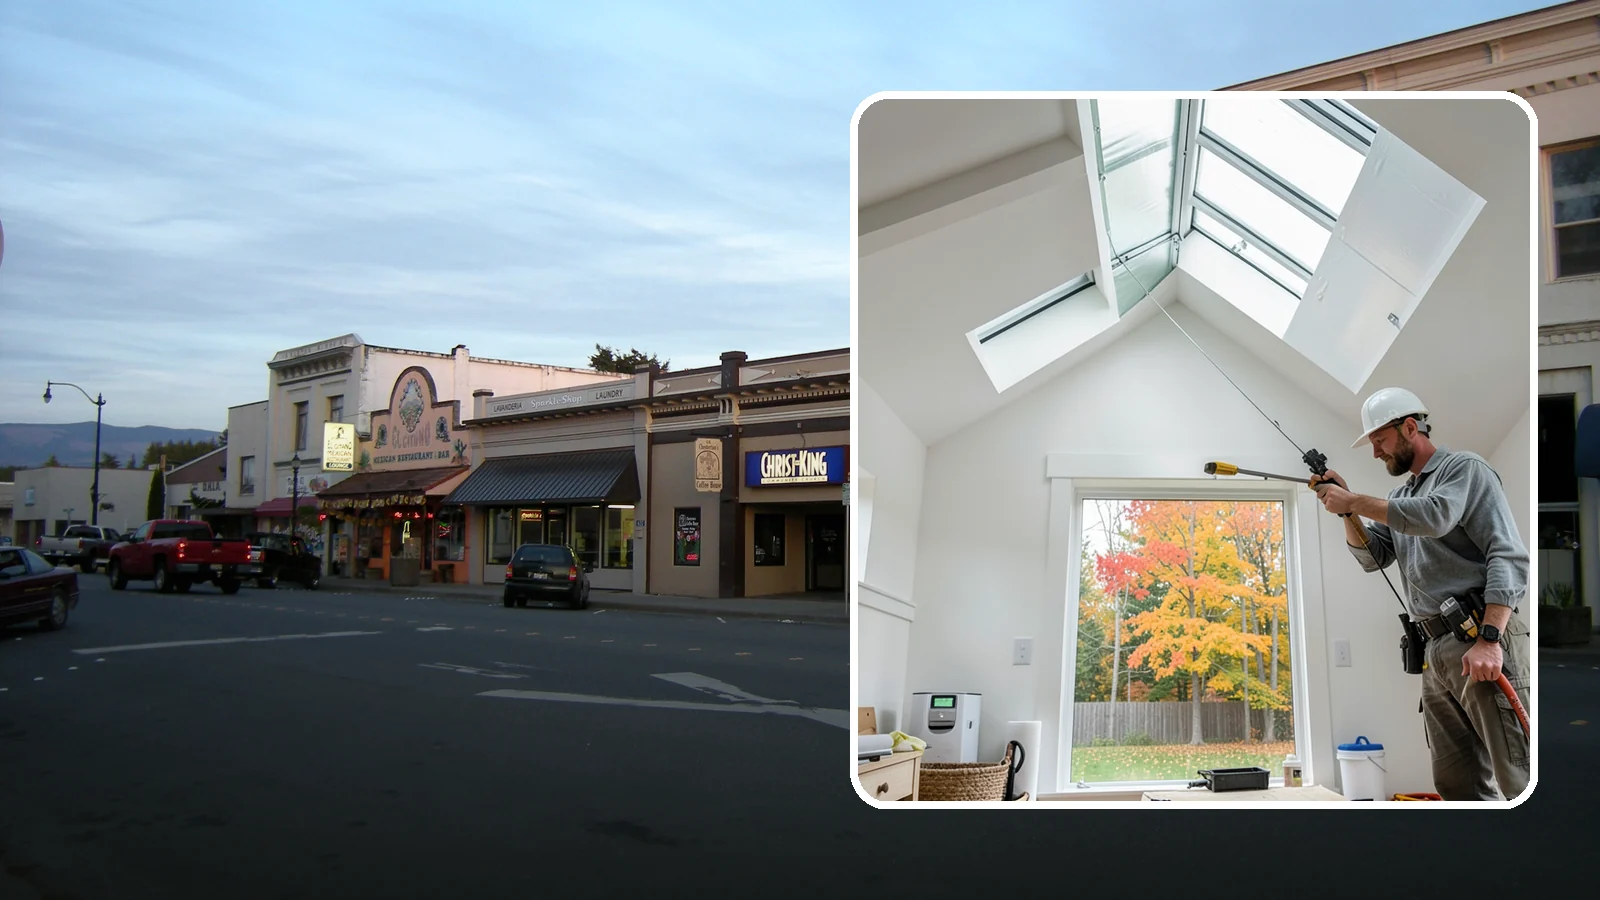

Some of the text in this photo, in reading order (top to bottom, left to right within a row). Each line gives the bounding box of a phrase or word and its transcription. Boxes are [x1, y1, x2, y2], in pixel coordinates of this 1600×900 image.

[595, 388, 624, 400] LAUNDRY
[493, 402, 523, 413] LAVANDERIA
[530, 394, 583, 409] Sparkle Shop
[391, 425, 402, 449] EL
[373, 454, 396, 464] MEXICAN
[397, 451, 434, 463] RESTAURANT
[437, 450, 451, 460] BAR
[760, 449, 828, 478] CHRIST KING
[696, 480, 709, 489] Coffee
